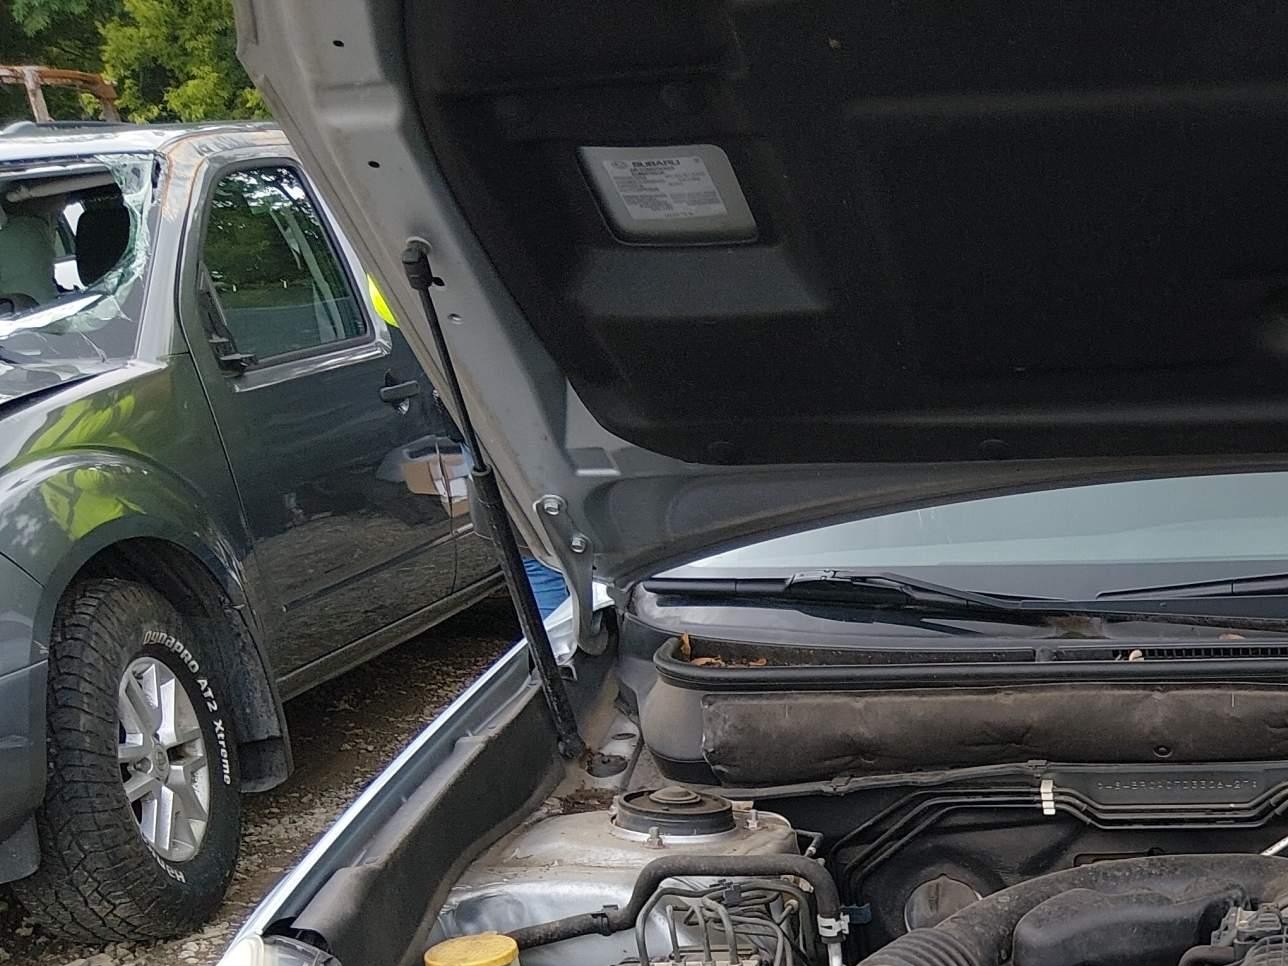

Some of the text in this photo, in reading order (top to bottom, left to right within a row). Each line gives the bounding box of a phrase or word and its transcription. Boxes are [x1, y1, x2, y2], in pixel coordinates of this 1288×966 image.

[631, 159, 681, 168] SUBARU
[196, 679, 218, 713] AT2
[213, 719, 231, 785] Xtreme
